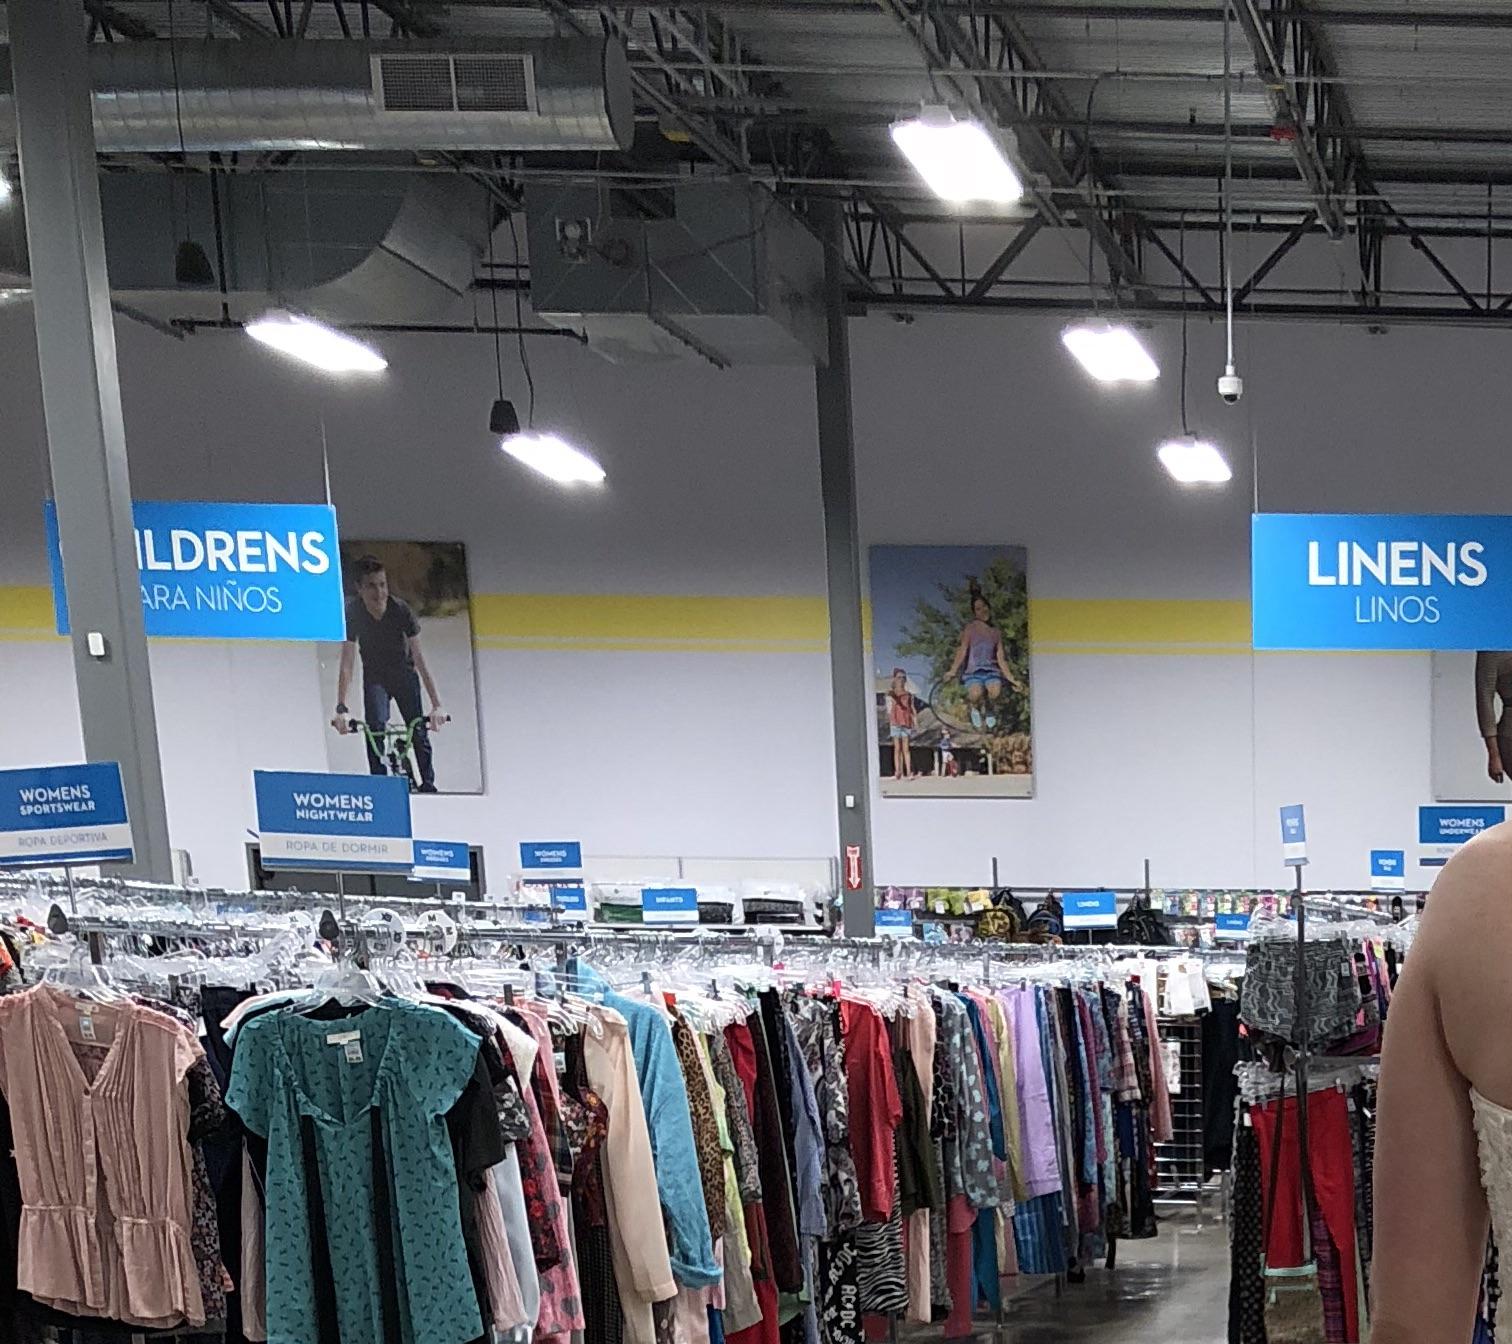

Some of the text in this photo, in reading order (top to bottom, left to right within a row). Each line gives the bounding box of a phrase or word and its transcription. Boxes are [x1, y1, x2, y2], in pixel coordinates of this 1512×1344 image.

[134, 529, 330, 575] ILDRENS
[1308, 541, 1488, 587] LINENS
[140, 579, 283, 613] ARA NIÑOS
[1356, 596, 1440, 623] LINOS
[19, 784, 91, 803] WOMENS
[293, 792, 374, 810] WOMENS
[20, 801, 96, 816] SPORTSWEAR
[296, 809, 373, 822] NIGHTWEAR
[1439, 818, 1485, 827] WOMENS
[286, 840, 389, 855] ROPA DE DORMIR
